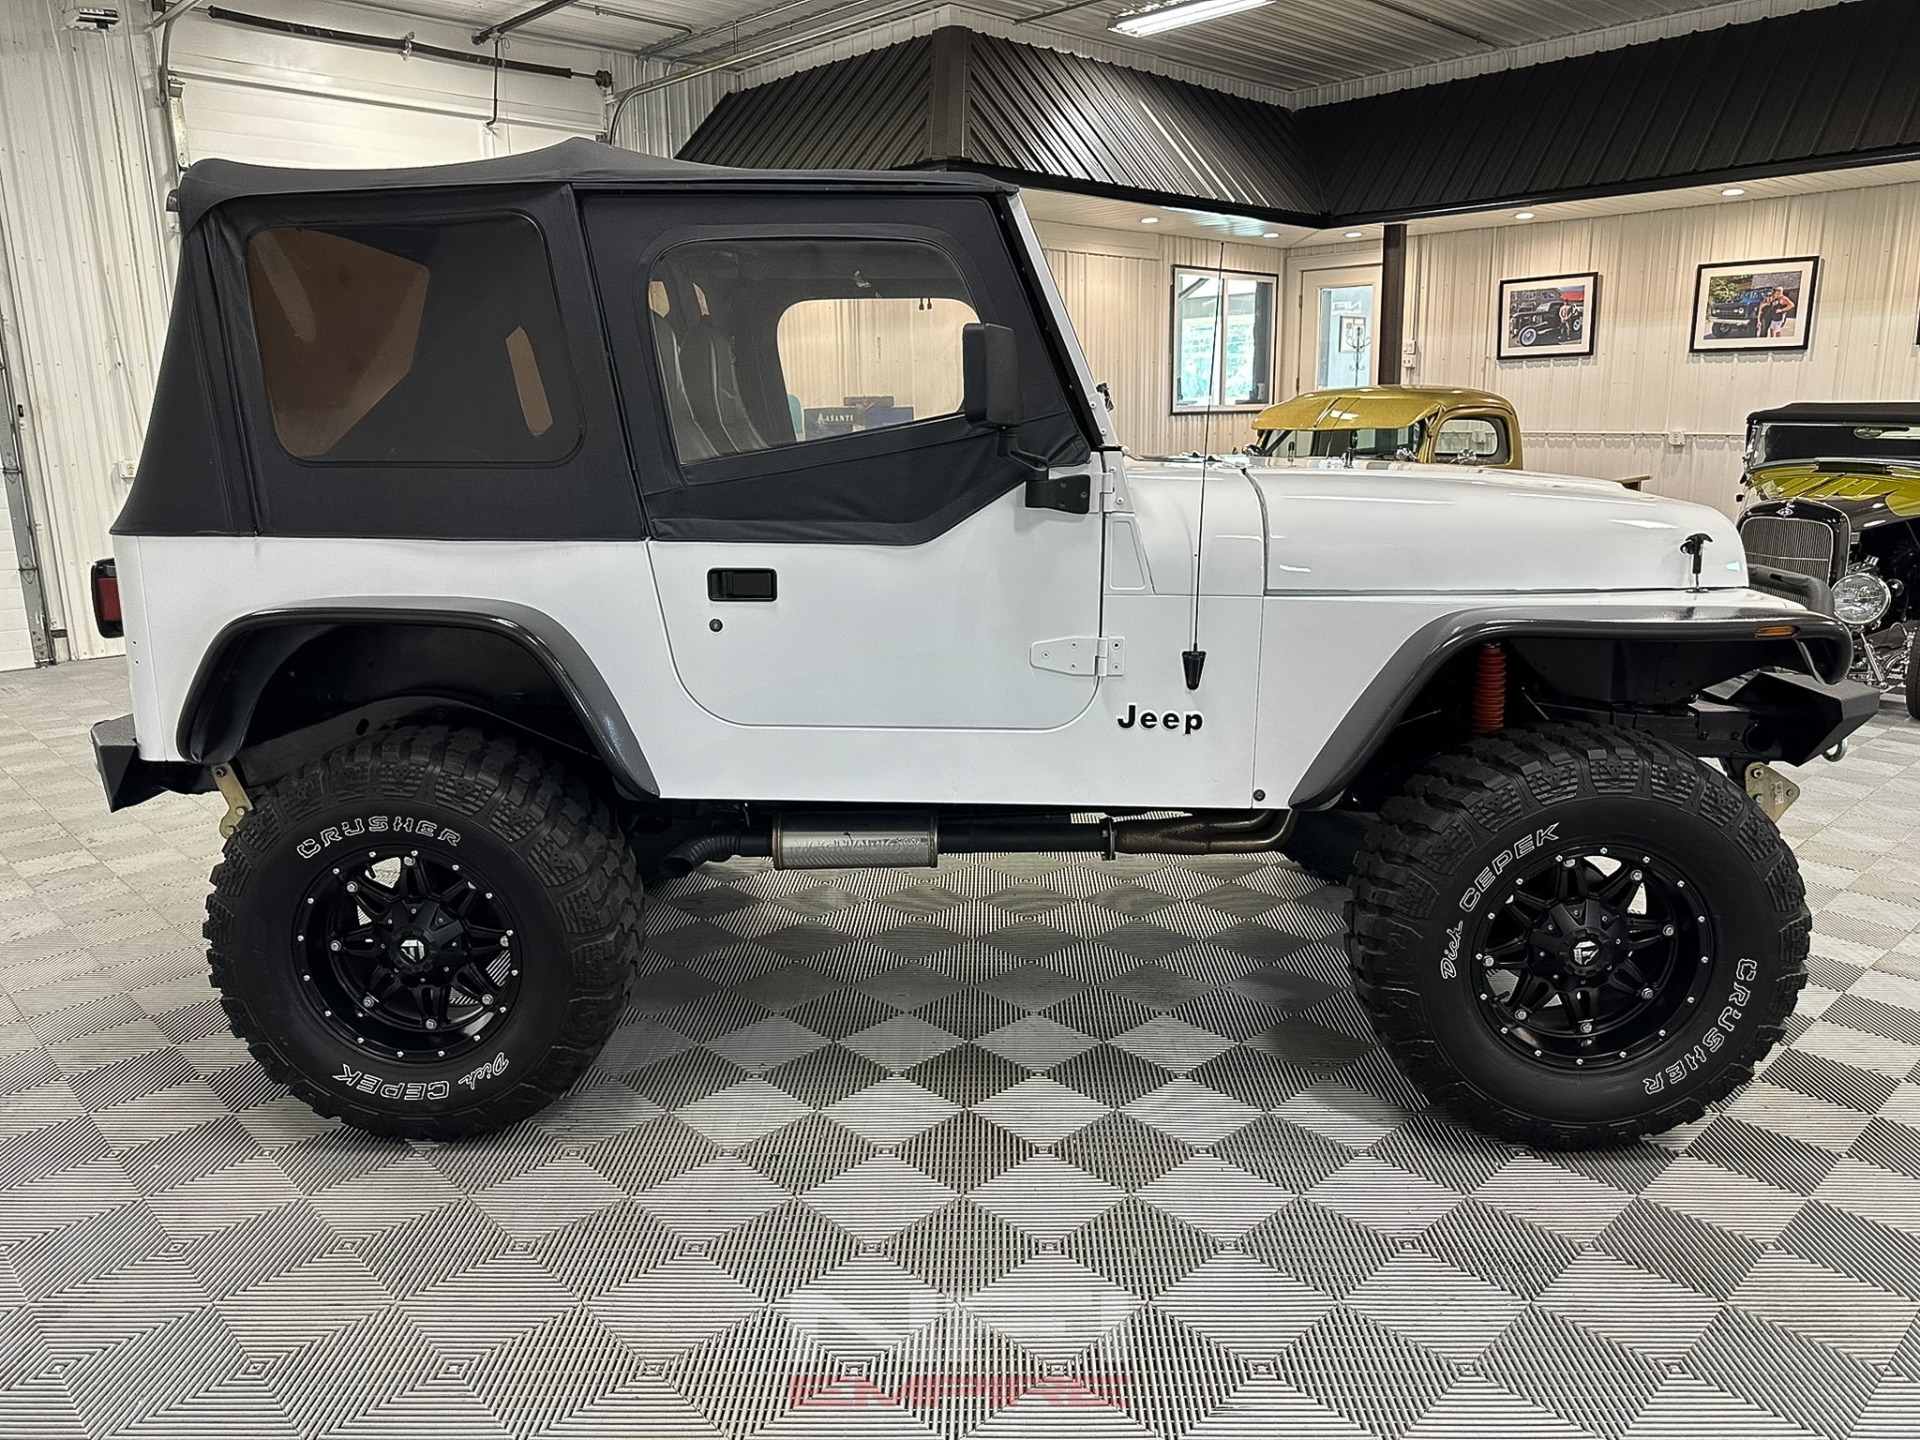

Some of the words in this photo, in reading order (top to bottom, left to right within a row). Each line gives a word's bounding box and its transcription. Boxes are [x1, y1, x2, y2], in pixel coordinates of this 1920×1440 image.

[1117, 704, 1203, 735] Jeep
[296, 815, 462, 860] CRUSHER
[1440, 920, 1464, 980] Dick
[1459, 821, 1560, 913] CEPEK
[1641, 958, 1758, 1095] CRUSHER
[331, 1062, 450, 1101] CEPEK
[457, 1051, 510, 1091] Dick
